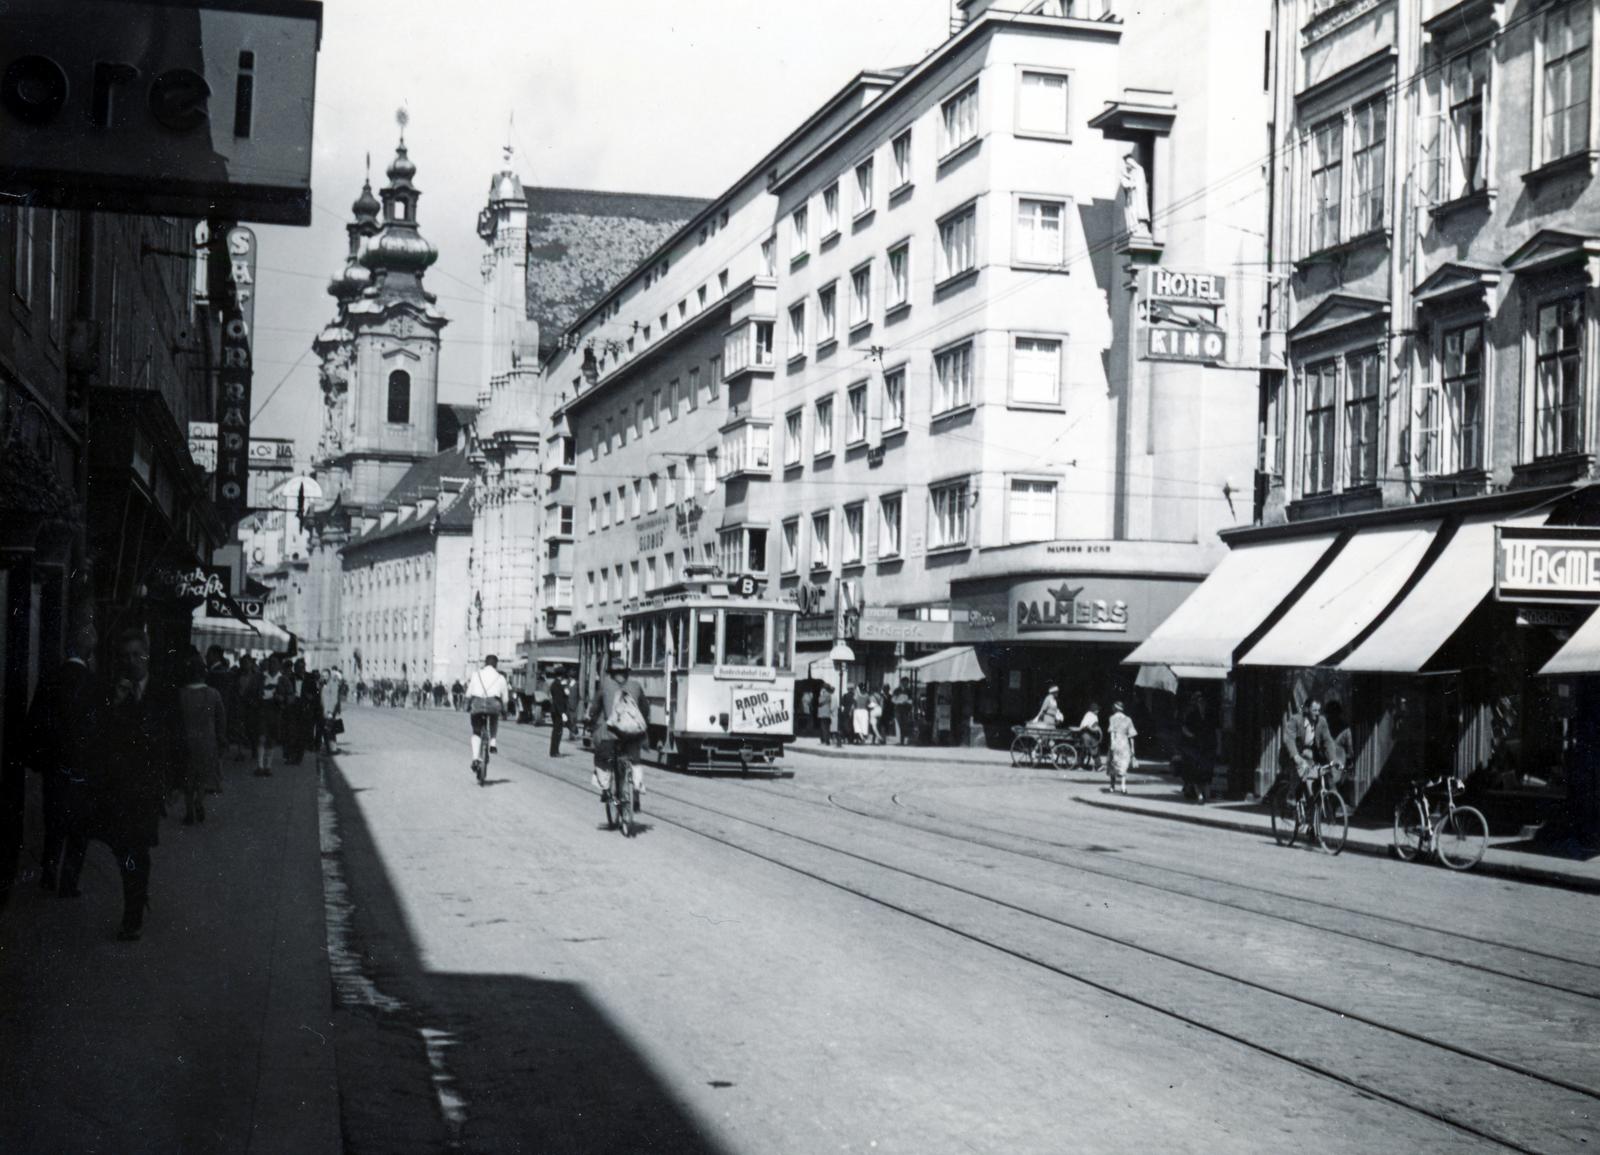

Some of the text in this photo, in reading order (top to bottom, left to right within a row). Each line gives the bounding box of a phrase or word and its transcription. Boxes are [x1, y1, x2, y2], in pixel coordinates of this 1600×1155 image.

[1156, 272, 1220, 299] HOTEL
[1151, 330, 1222, 357] KINO
[222, 382, 247, 499] RADIO
[175, 573, 227, 598] Trafik
[742, 579, 754, 594] B
[1017, 599, 1128, 625] PALMERS
[735, 692, 769, 710] RADIO
[756, 710, 789, 728] SCHAU
